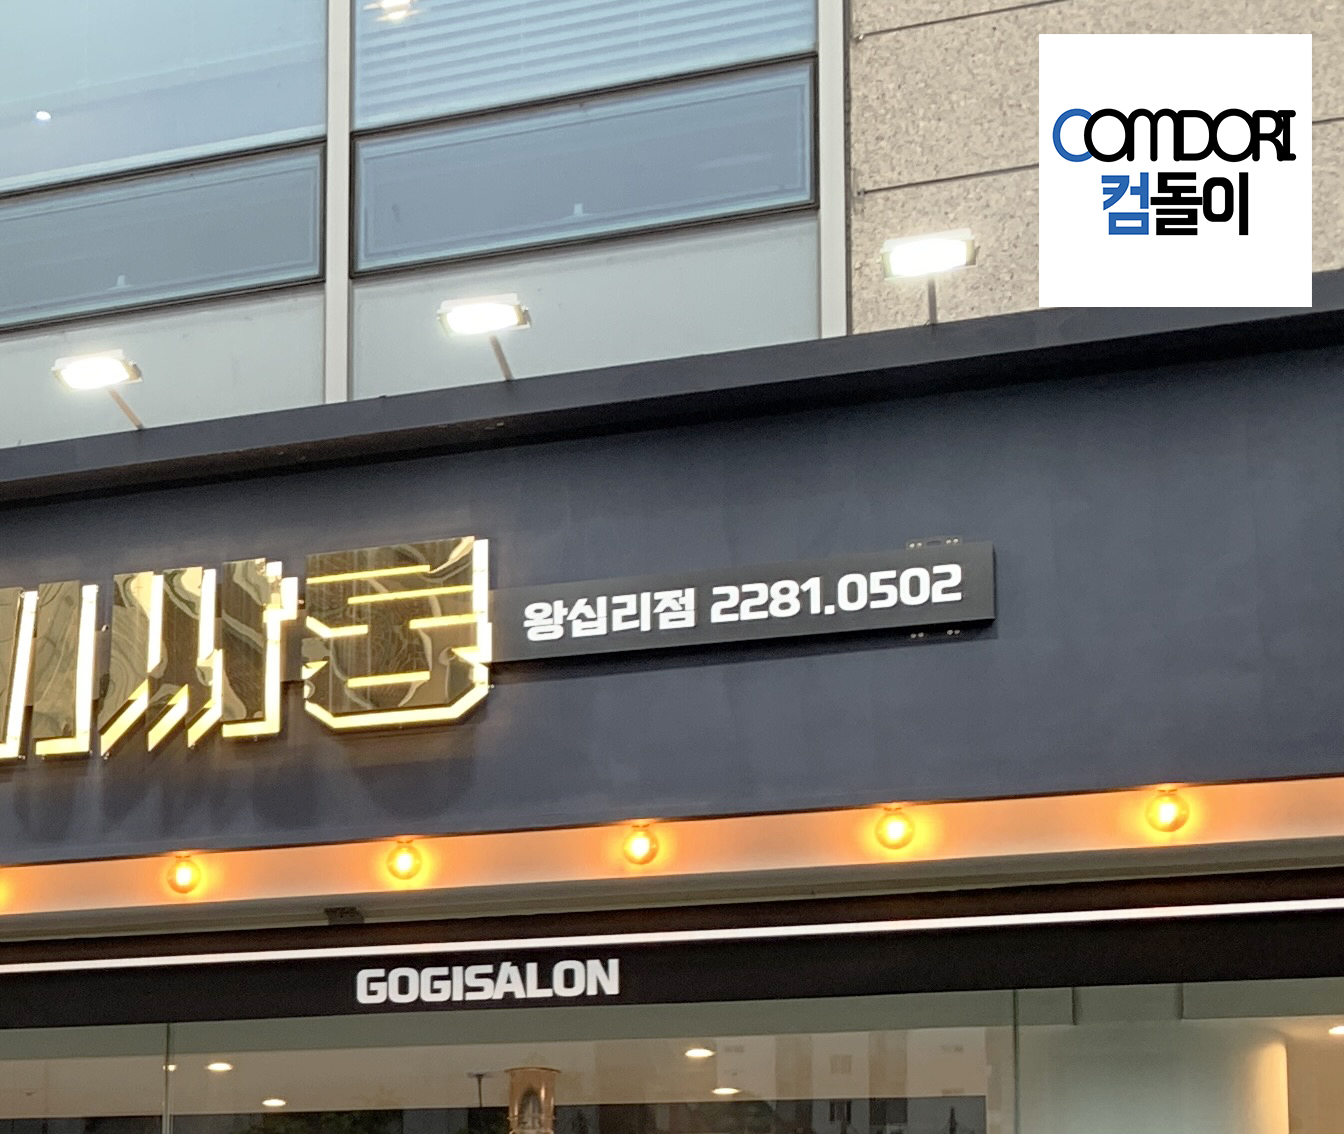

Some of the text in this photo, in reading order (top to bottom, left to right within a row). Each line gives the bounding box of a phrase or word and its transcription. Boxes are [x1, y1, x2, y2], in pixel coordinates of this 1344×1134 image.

[523, 564, 962, 643] 왕십리점 2281.0502
[356, 958, 620, 1005] GOGISALON
